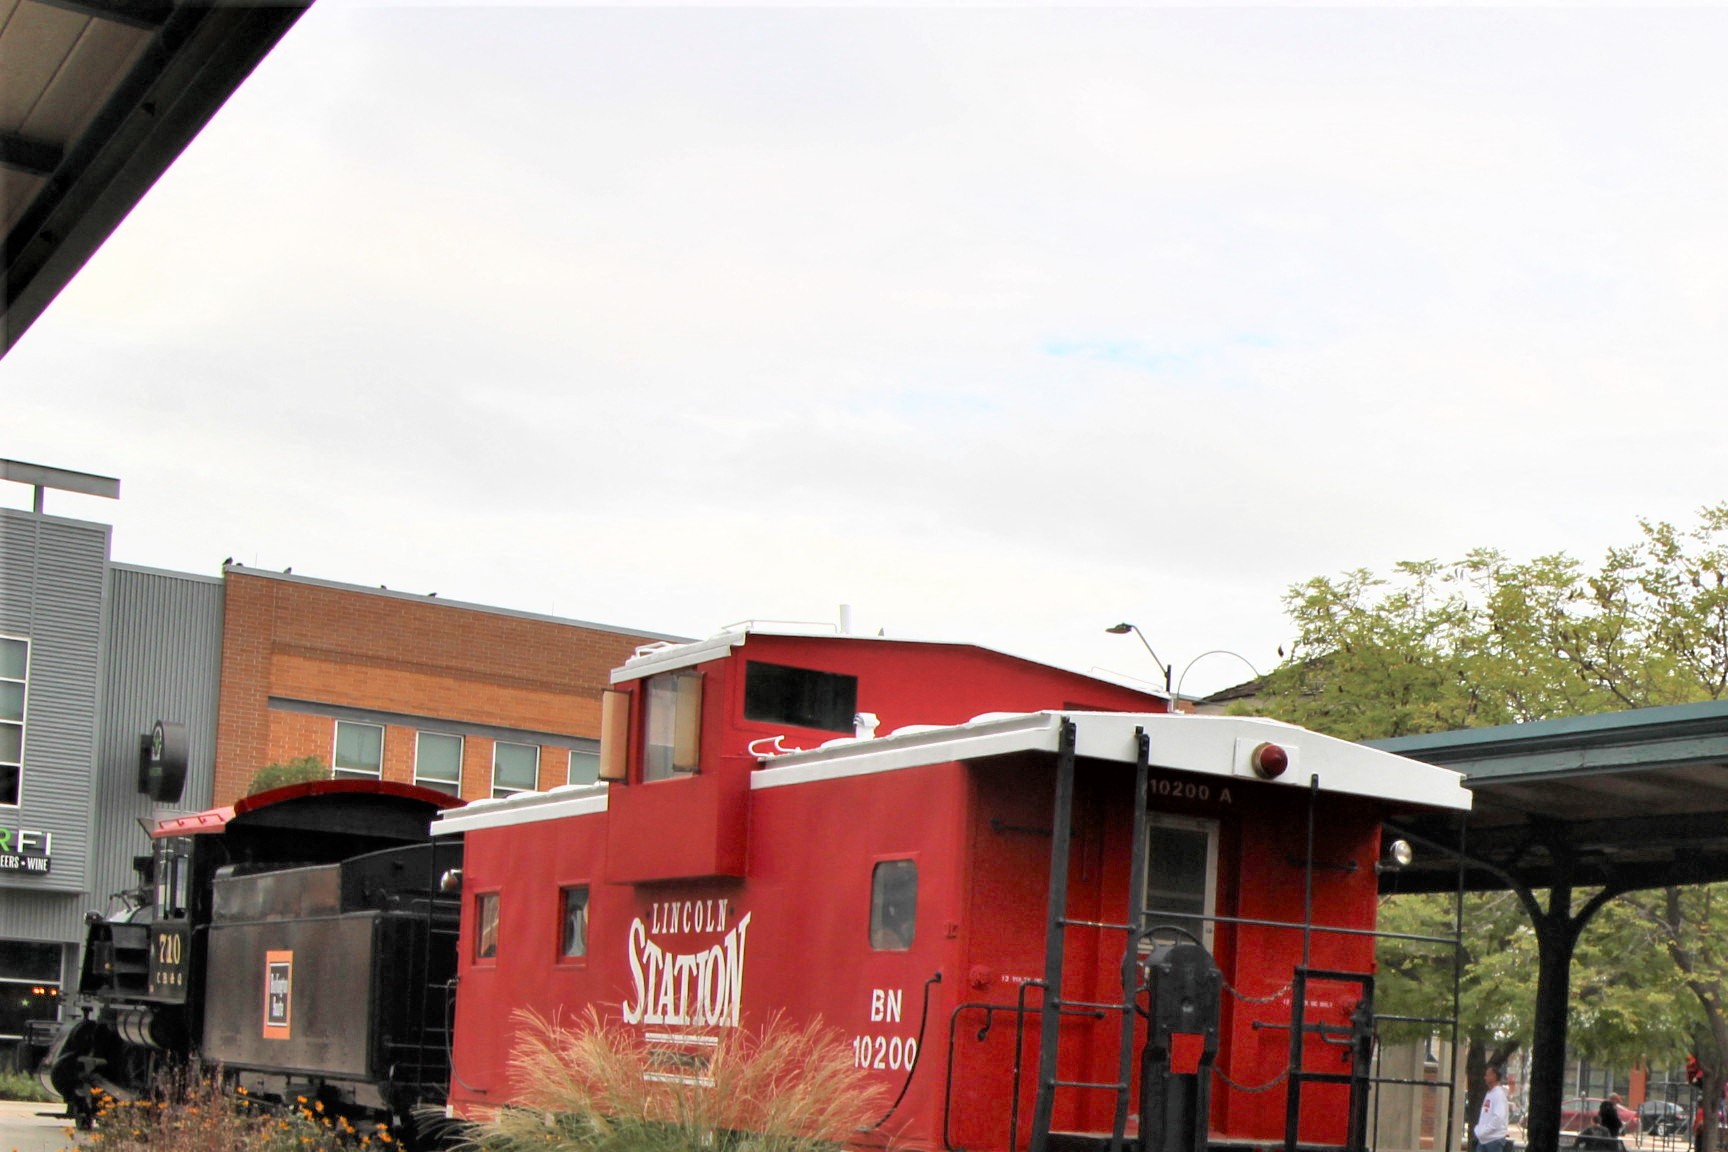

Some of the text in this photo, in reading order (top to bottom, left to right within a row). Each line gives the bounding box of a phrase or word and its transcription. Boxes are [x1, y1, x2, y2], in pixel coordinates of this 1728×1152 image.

[1150, 779, 1232, 804] 10200 A
[27, 857, 48, 871] WINE
[652, 899, 729, 934] LINCOLN
[160, 933, 180, 964] 710
[623, 911, 751, 1027] STATION
[871, 988, 902, 1022] BN
[853, 1035, 917, 1072] 10200
